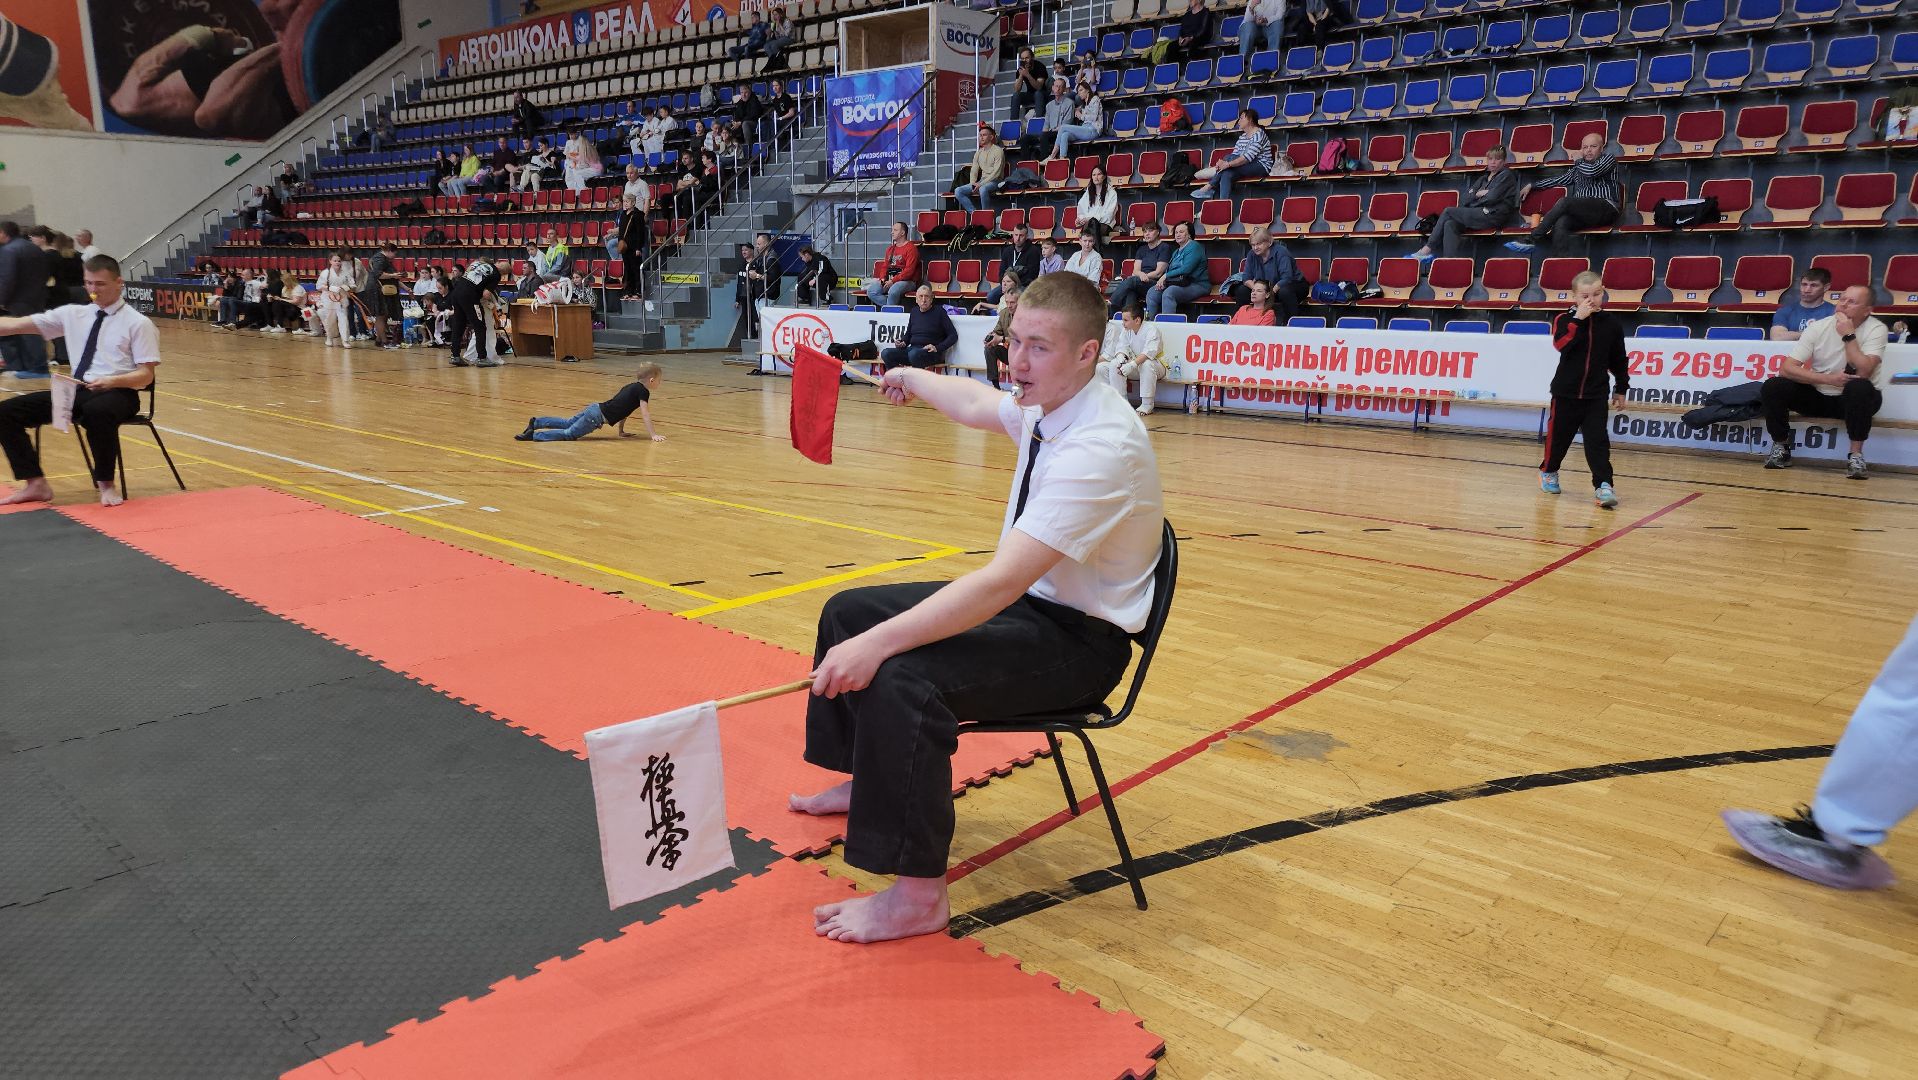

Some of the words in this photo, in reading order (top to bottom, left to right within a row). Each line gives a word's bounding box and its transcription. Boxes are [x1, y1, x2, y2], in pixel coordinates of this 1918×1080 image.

[458, 20, 571, 66] АВТОШКОЛА
[595, 1, 655, 41] РЕАЛ
[947, 29, 994, 49] ВОСТОК
[842, 99, 910, 125] ВОСТОК
[128, 287, 153, 301] СЕРВИС
[156, 289, 213, 316] РЕМОНТ
[1186, 334, 1348, 372] Слесарный
[1355, 346, 1478, 379] ремонт
[1671, 351, 1788, 381] 269-39
[1198, 369, 1329, 407] Кузовной
[1335, 383, 1456, 416] ремонт
[1613, 414, 1767, 447] Совхозная,
